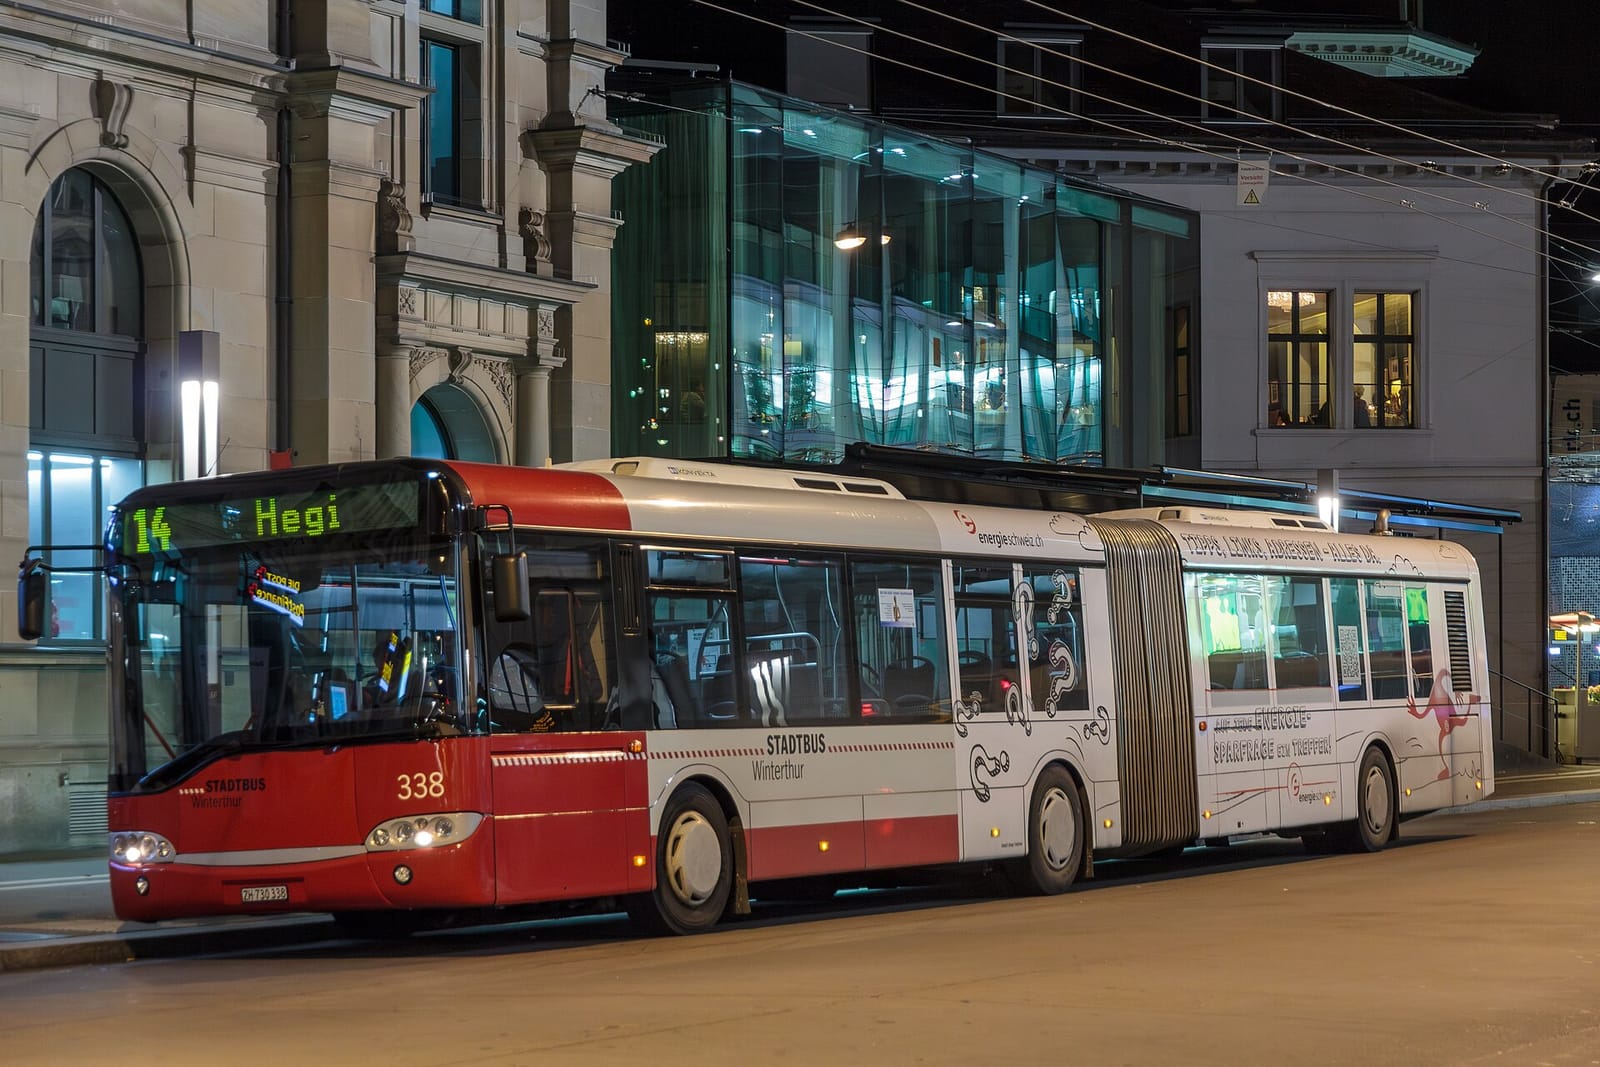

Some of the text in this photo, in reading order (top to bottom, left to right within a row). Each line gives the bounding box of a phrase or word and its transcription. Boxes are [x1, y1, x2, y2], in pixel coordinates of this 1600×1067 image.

[133, 494, 341, 553] 14 Hegi
[978, 530, 1045, 549] energieschweiz.ch
[1180, 533, 1227, 558] TIPPS,
[767, 733, 826, 756] STADTBUS
[1213, 738, 1275, 764] SPARFRAGE
[1291, 733, 1332, 757] TREFFER!
[751, 758, 805, 781] Winterthur
[205, 778, 266, 793] STADTBUS
[397, 771, 445, 800] 338
[191, 796, 242, 809] Winterthur
[242, 890, 254, 901] ZH
